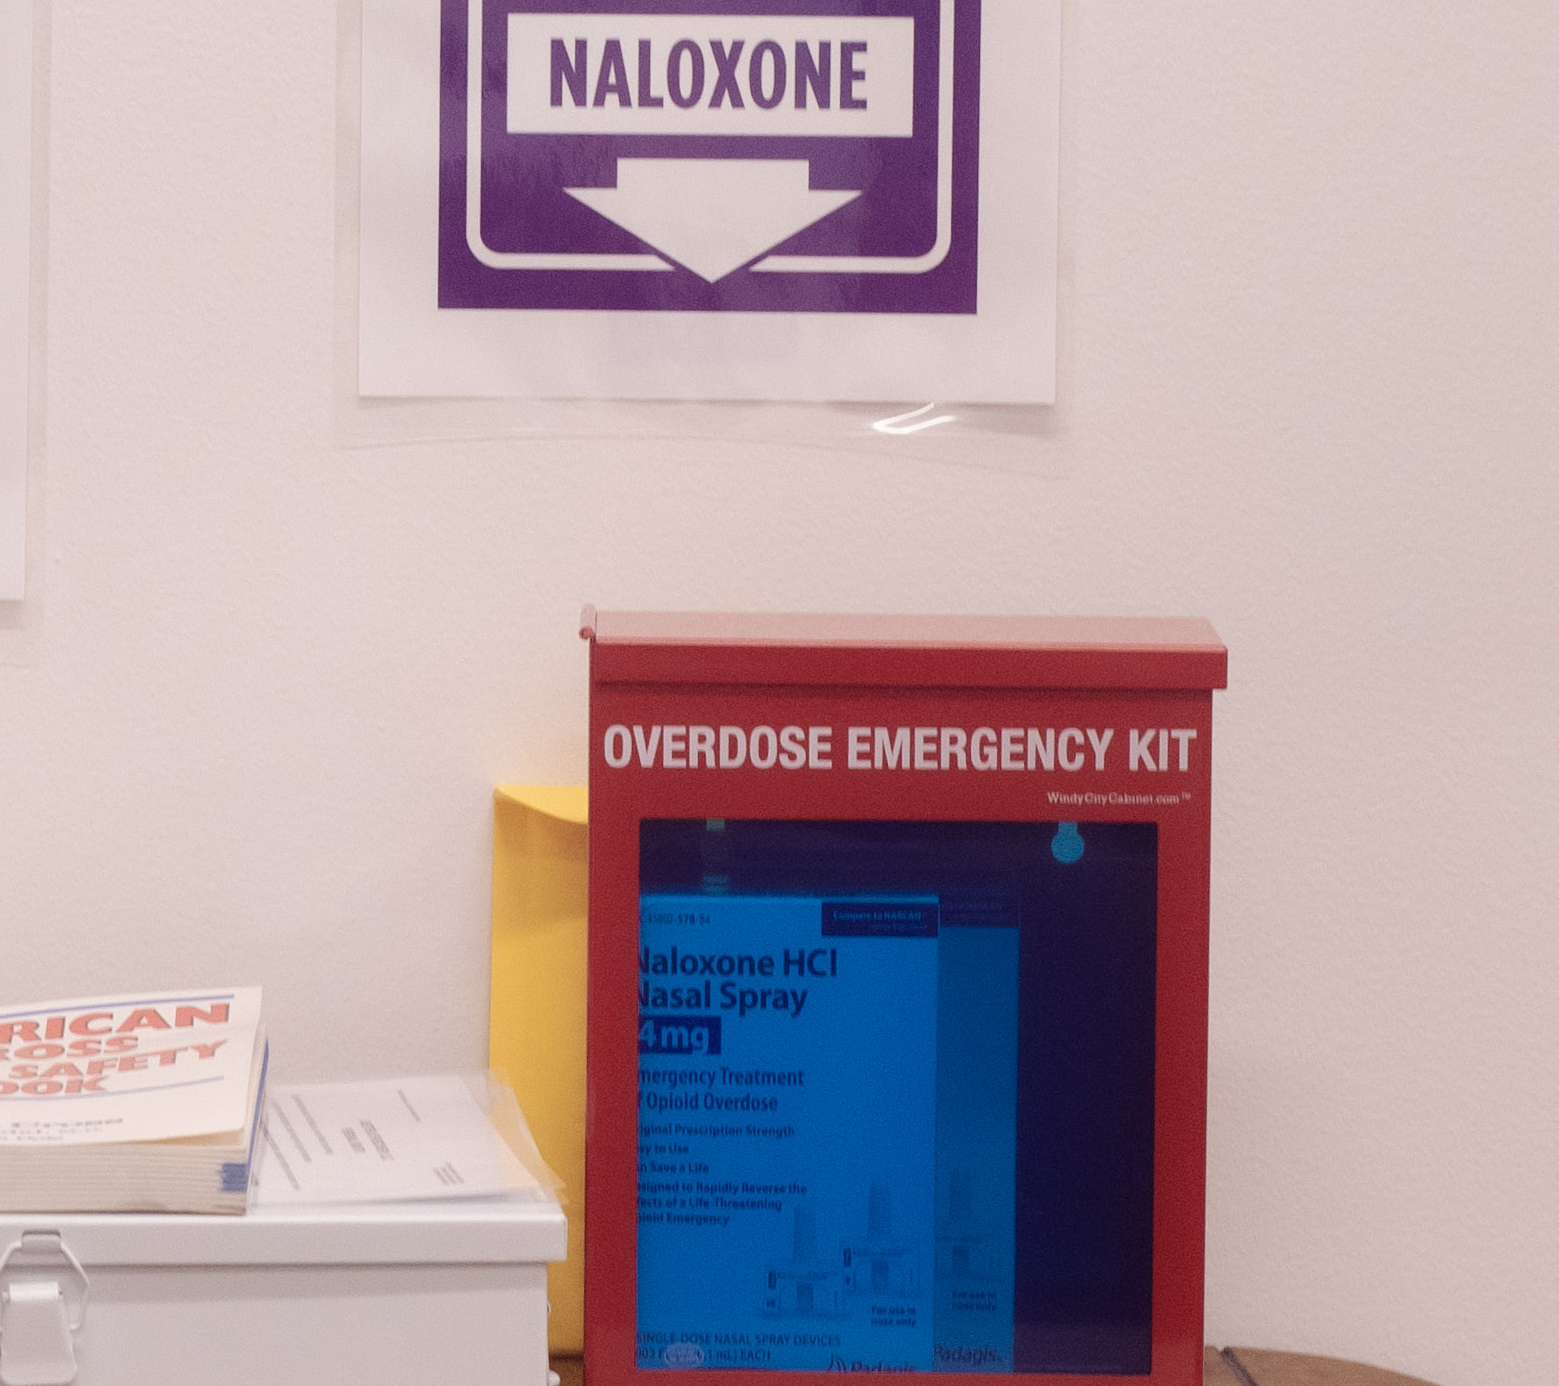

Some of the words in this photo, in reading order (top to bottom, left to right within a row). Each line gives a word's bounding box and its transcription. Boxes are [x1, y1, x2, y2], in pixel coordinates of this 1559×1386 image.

[548, 35, 870, 113] NALOXONE
[603, 723, 833, 770] OVERDOSE
[847, 725, 1115, 772] EMERGENCY
[1128, 728, 1198, 773] KIT
[719, 981, 808, 1019] Spray
[8, 1038, 229, 1079] SAFETY
[638, 1069, 717, 1089] mergency
[720, 1066, 805, 1087] Treatment
[646, 1090, 699, 1114] Opioid
[703, 1090, 778, 1113] Overdose
[674, 1123, 743, 1139] Prescription
[745, 1124, 795, 1140] Strength
[654, 1142, 666, 1154] to
[668, 1142, 689, 1155] Use
[650, 1160, 677, 1174] Save
[679, 1162, 686, 1173] a
[688, 1161, 710, 1174] Life
[681, 1182, 694, 1193] to
[696, 1181, 739, 1195] Rapidly
[741, 1181, 786, 1195] Reverse
[788, 1181, 808, 1195] the
[665, 1213, 730, 1228] Emergency
[713, 1332, 751, 1345] NASAL
[754, 1333, 791, 1346] SPRAY
[794, 1333, 841, 1347] DEVICES
[739, 1349, 772, 1362] EACH
